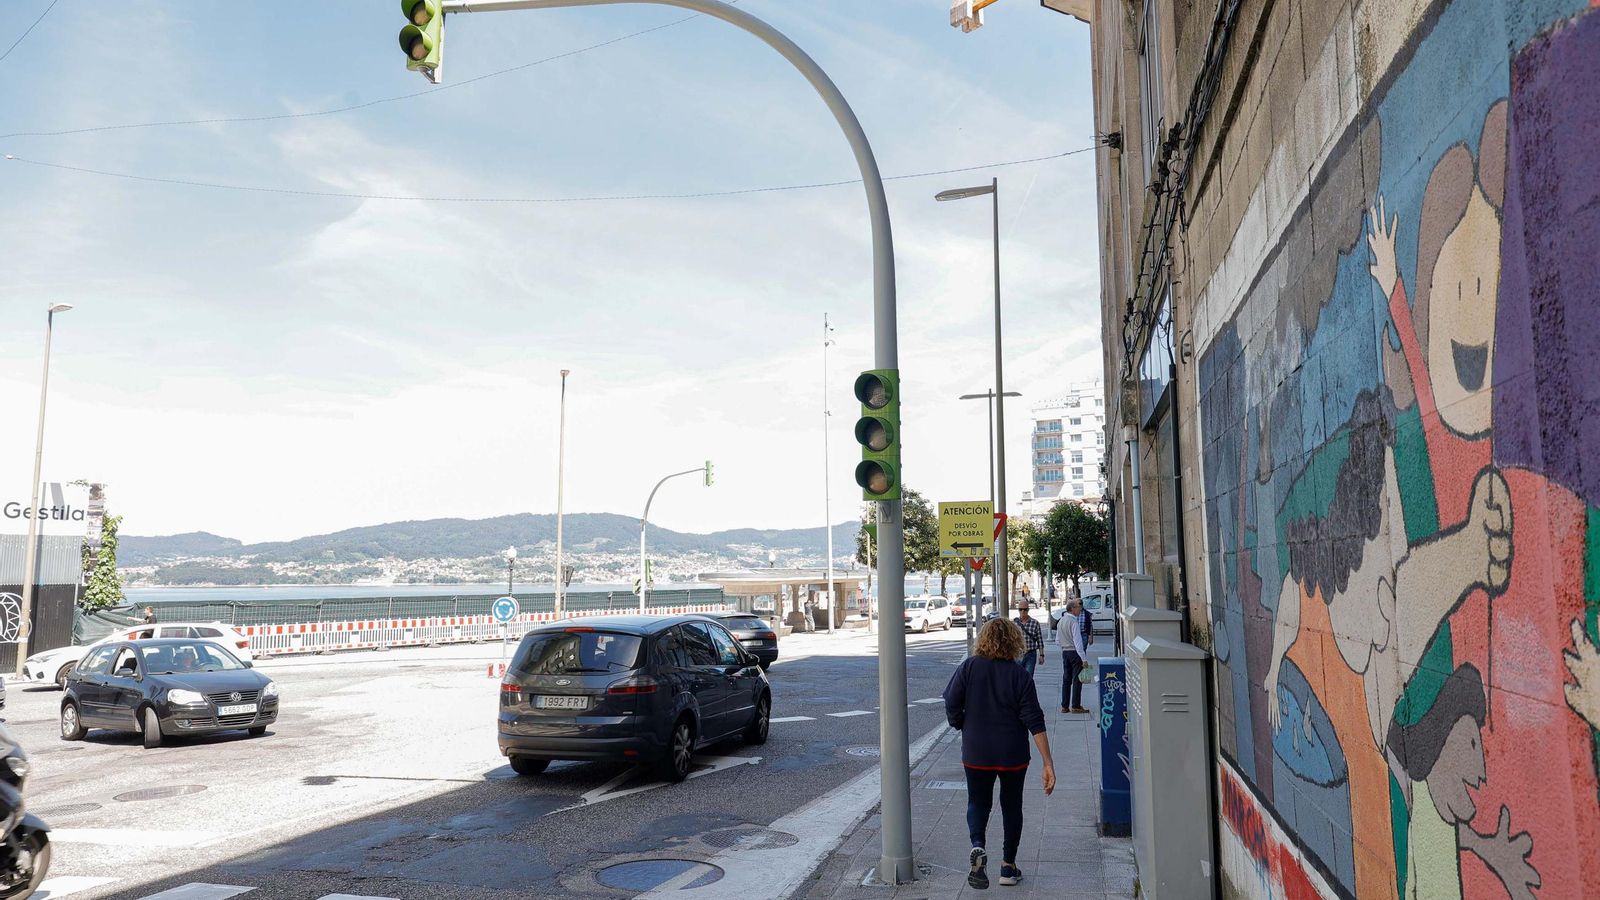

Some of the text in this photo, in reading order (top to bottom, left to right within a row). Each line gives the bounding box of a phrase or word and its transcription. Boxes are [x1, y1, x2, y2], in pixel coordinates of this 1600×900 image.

[3, 502, 85, 521] Gestila
[943, 505, 989, 515] ATENCIÓN
[544, 697, 586, 707] 1992 FRY
